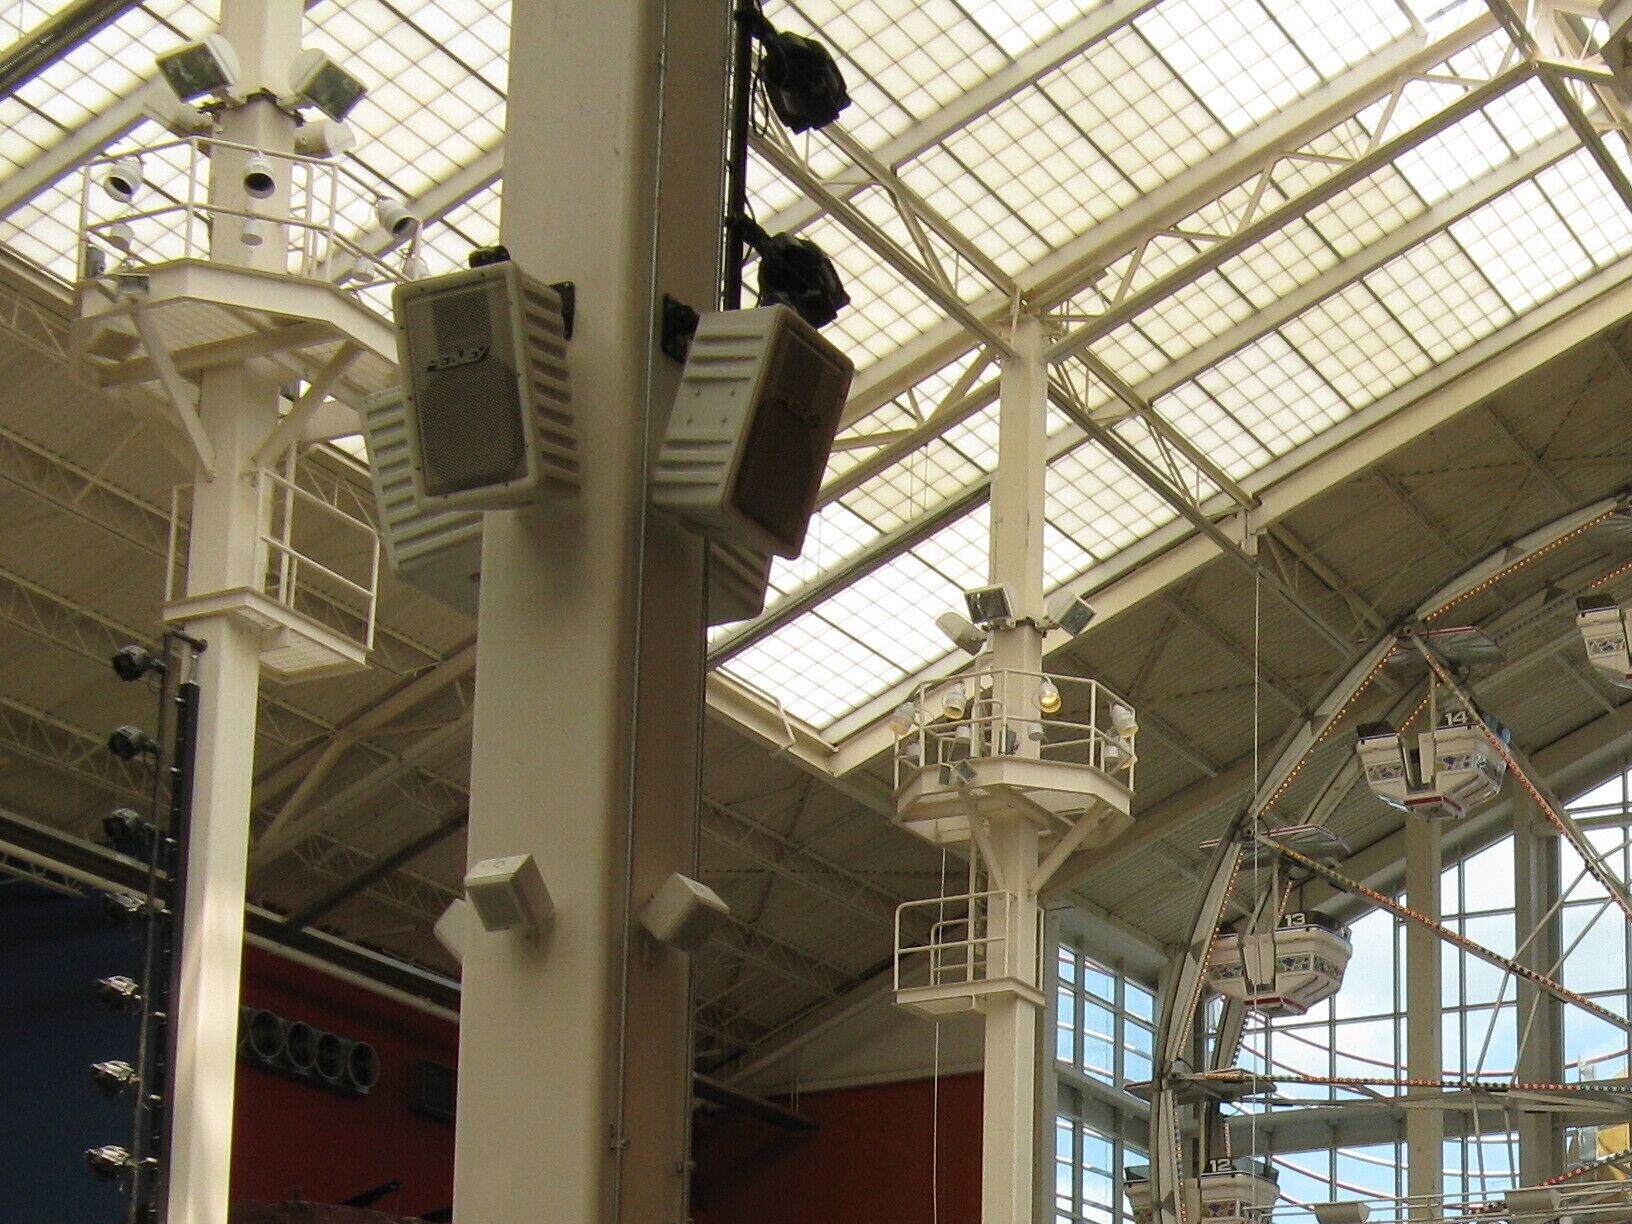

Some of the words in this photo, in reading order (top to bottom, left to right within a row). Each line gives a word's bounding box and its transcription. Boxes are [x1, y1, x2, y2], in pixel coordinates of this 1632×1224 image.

[1444, 710, 1469, 726] 14
[1284, 911, 1307, 927] 13
[1209, 1158, 1232, 1172] 12
